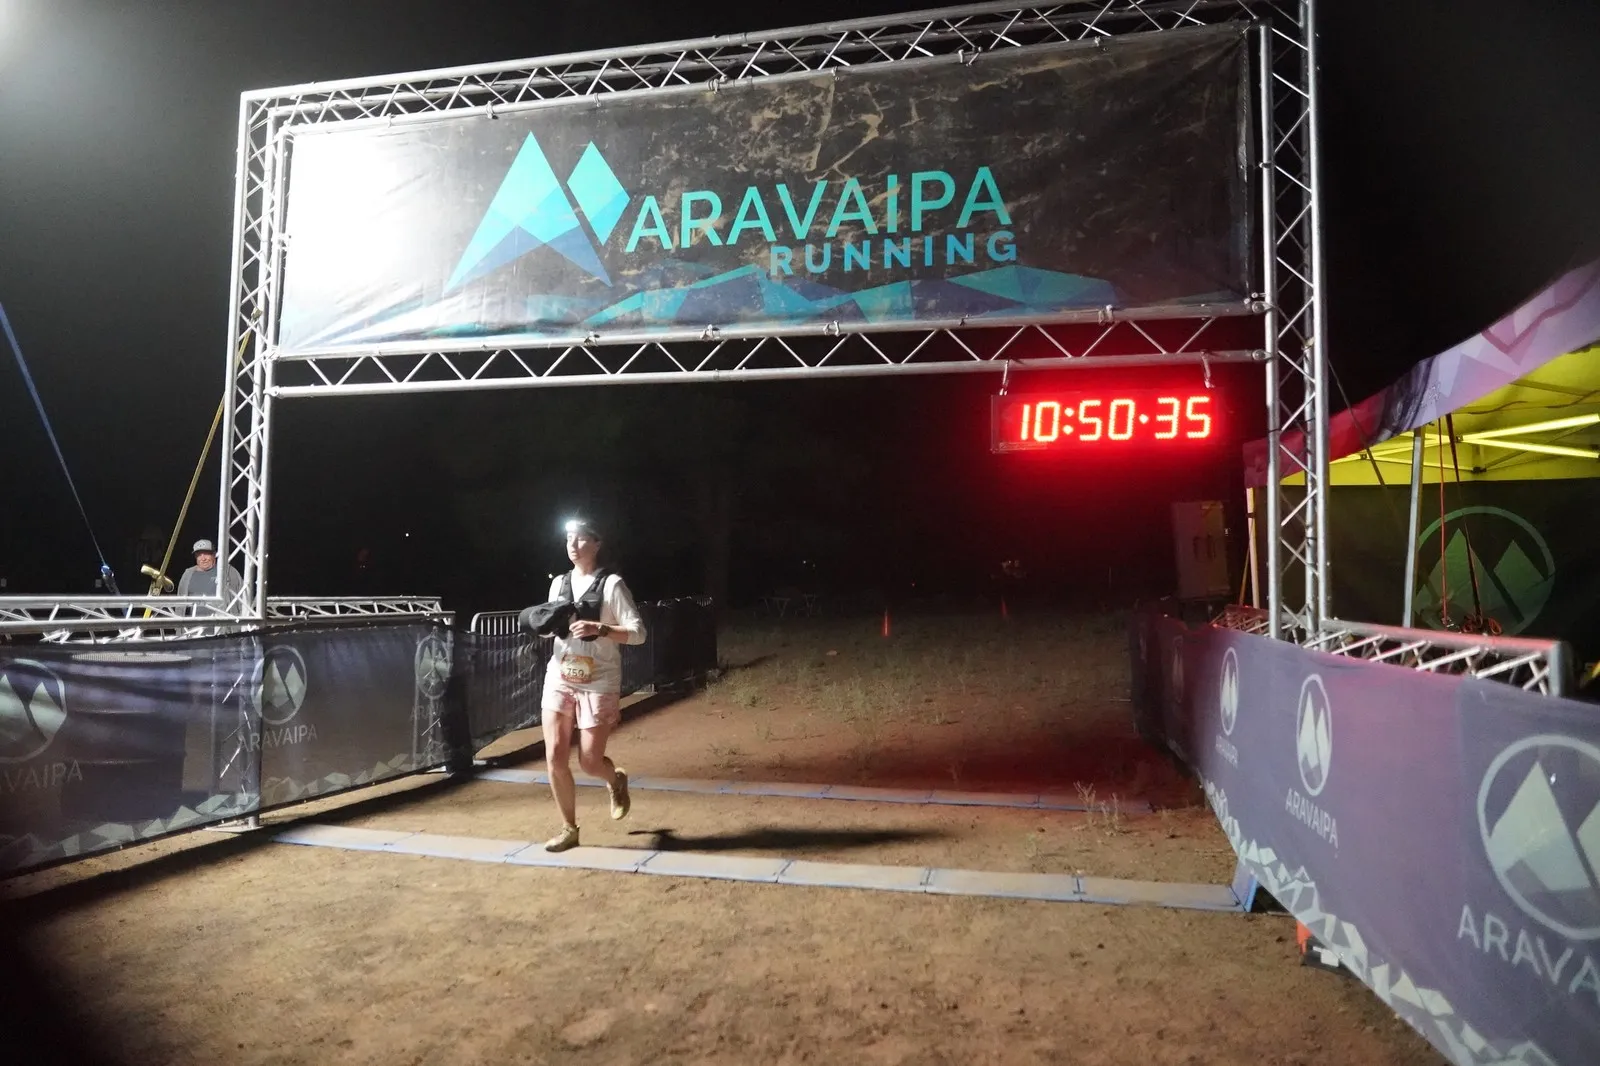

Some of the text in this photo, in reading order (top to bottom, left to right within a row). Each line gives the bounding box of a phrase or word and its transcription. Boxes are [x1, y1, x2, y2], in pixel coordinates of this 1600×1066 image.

[626, 166, 1012, 253] ARAVAIPA
[770, 230, 1018, 277] RUNNING
[235, 724, 318, 753] ARAVAIPA
[0, 759, 84, 790] VAIPA
[1285, 787, 1339, 849] ARAVAIPA
